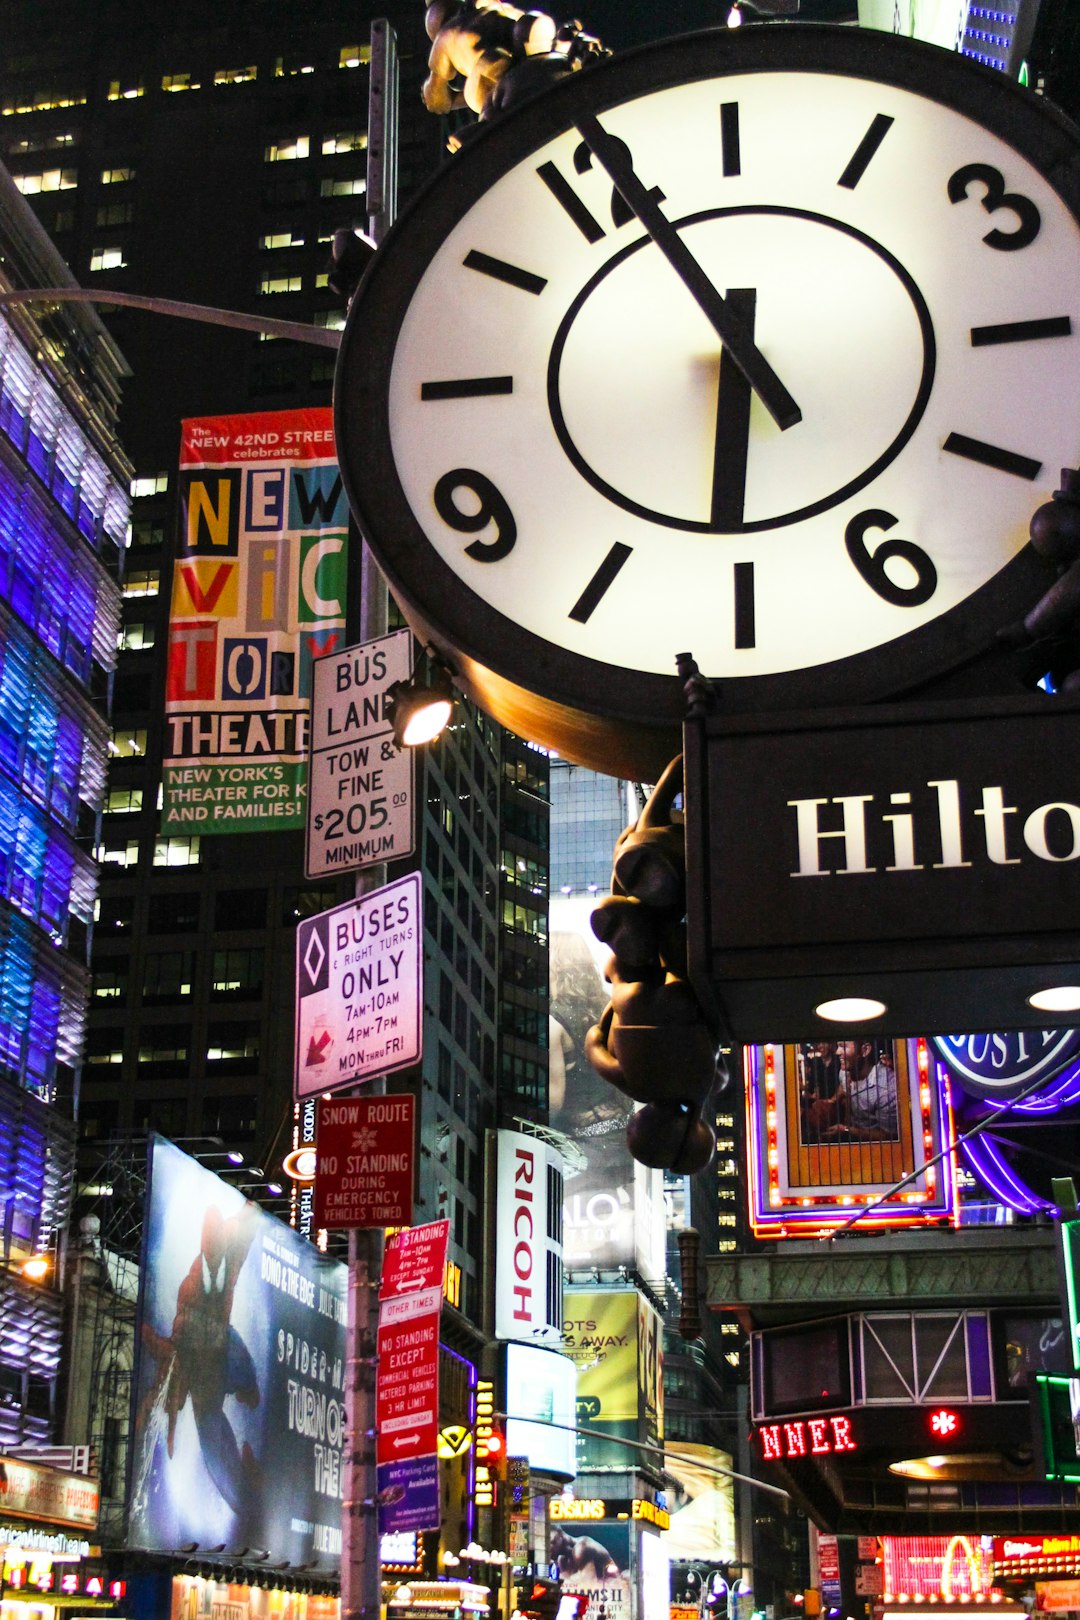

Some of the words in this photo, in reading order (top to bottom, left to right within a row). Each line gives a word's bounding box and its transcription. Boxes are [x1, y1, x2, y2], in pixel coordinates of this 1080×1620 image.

[947, 163, 1041, 252] 3
[191, 437, 229, 448] NEW
[234, 433, 280, 446] 42ND
[192, 428, 211, 436] The
[233, 448, 300, 458] celebrates
[187, 471, 344, 547] NEW
[433, 468, 517, 563] 9
[844, 508, 938, 608] 6
[337, 651, 387, 693] BUS
[327, 746, 370, 775] TOW
[380, 740, 395, 761] &
[169, 768, 212, 785] NEW
[217, 766, 284, 782] YORK'S
[338, 769, 384, 800] FINE
[168, 786, 247, 804] THEATER
[253, 784, 289, 799] FOR
[295, 783, 307, 797] K
[167, 806, 208, 822] AND
[214, 802, 302, 819] FAMILIES!
[787, 779, 1080, 877] Hilto
[326, 834, 394, 865] MINIMUM
[337, 896, 410, 952] BUSES
[344, 944, 373, 966] RIGHT
[380, 927, 413, 950] TURNS
[341, 950, 405, 1000] ONLY
[338, 1053, 365, 1071] MON
[385, 1035, 404, 1056] FRI
[322, 1105, 359, 1126] SNOW
[368, 1103, 409, 1123] ROUTE
[320, 1156, 337, 1175] NO
[347, 1153, 408, 1174] STANDING
[341, 1176, 386, 1190] DURING
[326, 1190, 400, 1206] EMERGENCY
[300, 1186, 314, 1240] THEATR
[324, 1207, 366, 1222] VEHICLES
[372, 1206, 402, 1220] TOWED
[389, 1236, 400, 1250] NO
[404, 1225, 445, 1247] STANDING
[513, 1148, 534, 1323] RICOH
[390, 1271, 410, 1282] EXCEPT
[412, 1266, 434, 1277] SUNDAY
[388, 1302, 409, 1316] OTHER
[413, 1296, 434, 1307] TIMES
[382, 1338, 392, 1353] NO
[396, 1327, 434, 1349] STANDING
[579, 1336, 628, 1347] AWAY.
[390, 1347, 425, 1368] EXCEPT
[379, 1369, 409, 1386] COMMERCIAL
[412, 1363, 436, 1378] VEHICLES
[380, 1385, 406, 1400] METERED
[409, 1379, 434, 1393] PARKING
[395, 1400, 405, 1412] HR
[407, 1396, 426, 1410] LIMIT
